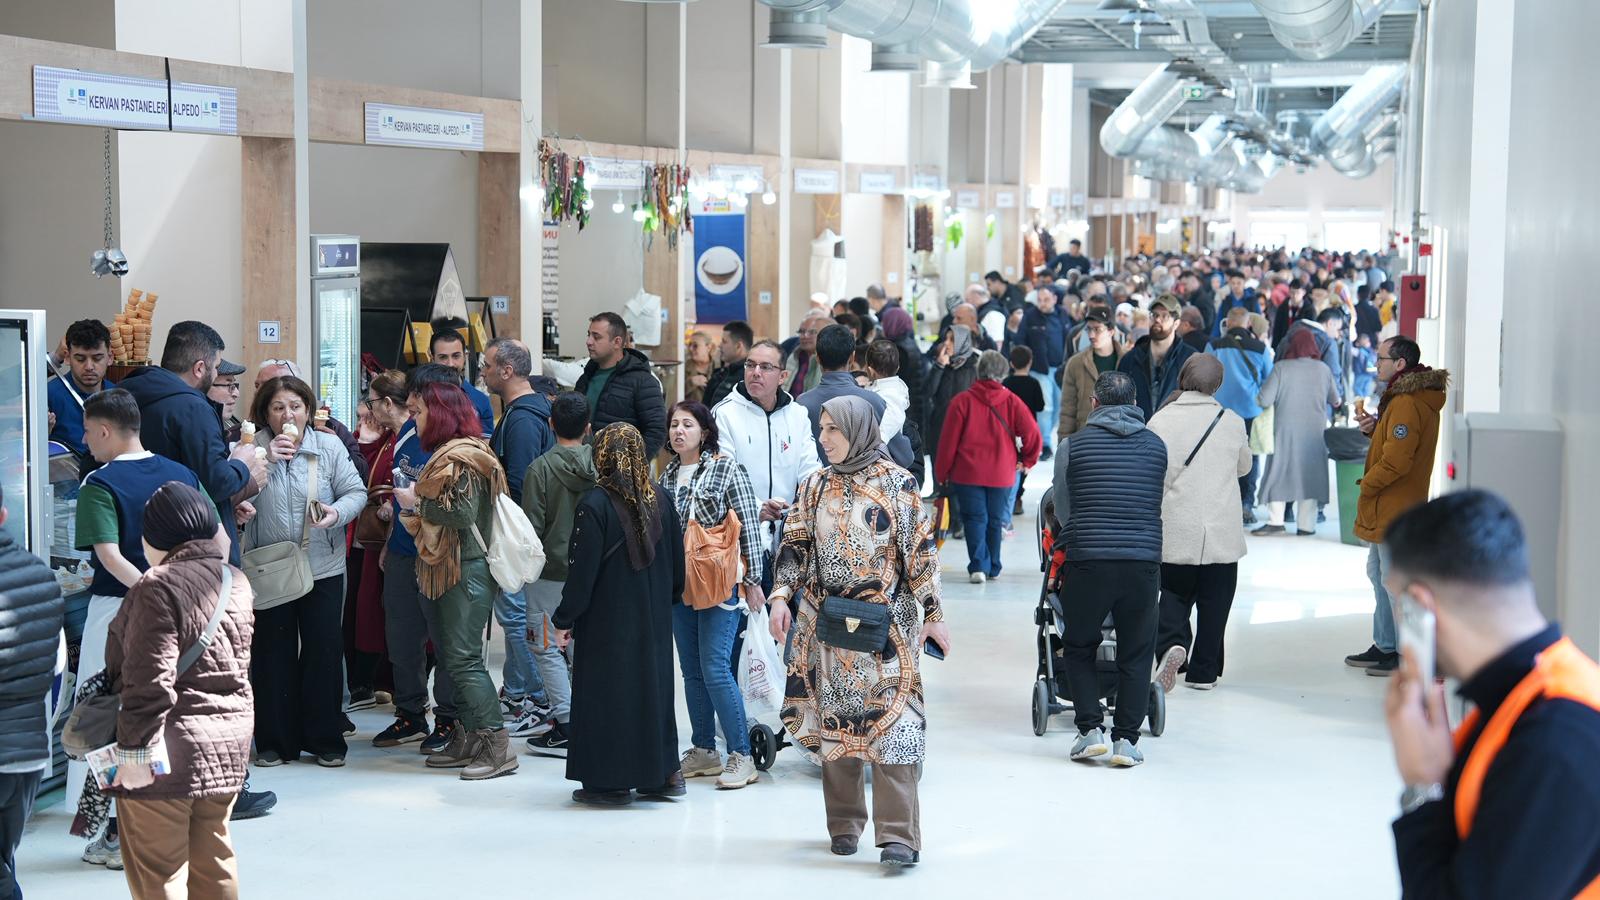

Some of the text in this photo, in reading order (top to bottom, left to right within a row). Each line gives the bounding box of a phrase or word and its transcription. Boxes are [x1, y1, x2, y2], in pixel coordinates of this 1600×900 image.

[89, 95, 119, 110] KERVAN
[121, 98, 168, 114] PASTANELERİ
[173, 103, 200, 117] ALPEDO
[394, 120, 411, 132] KERVAN
[412, 121, 440, 135] PASTANELERİ
[443, 125, 460, 136] ALPEDO
[496, 301, 505, 309] 13
[263, 327, 275, 337] 12
